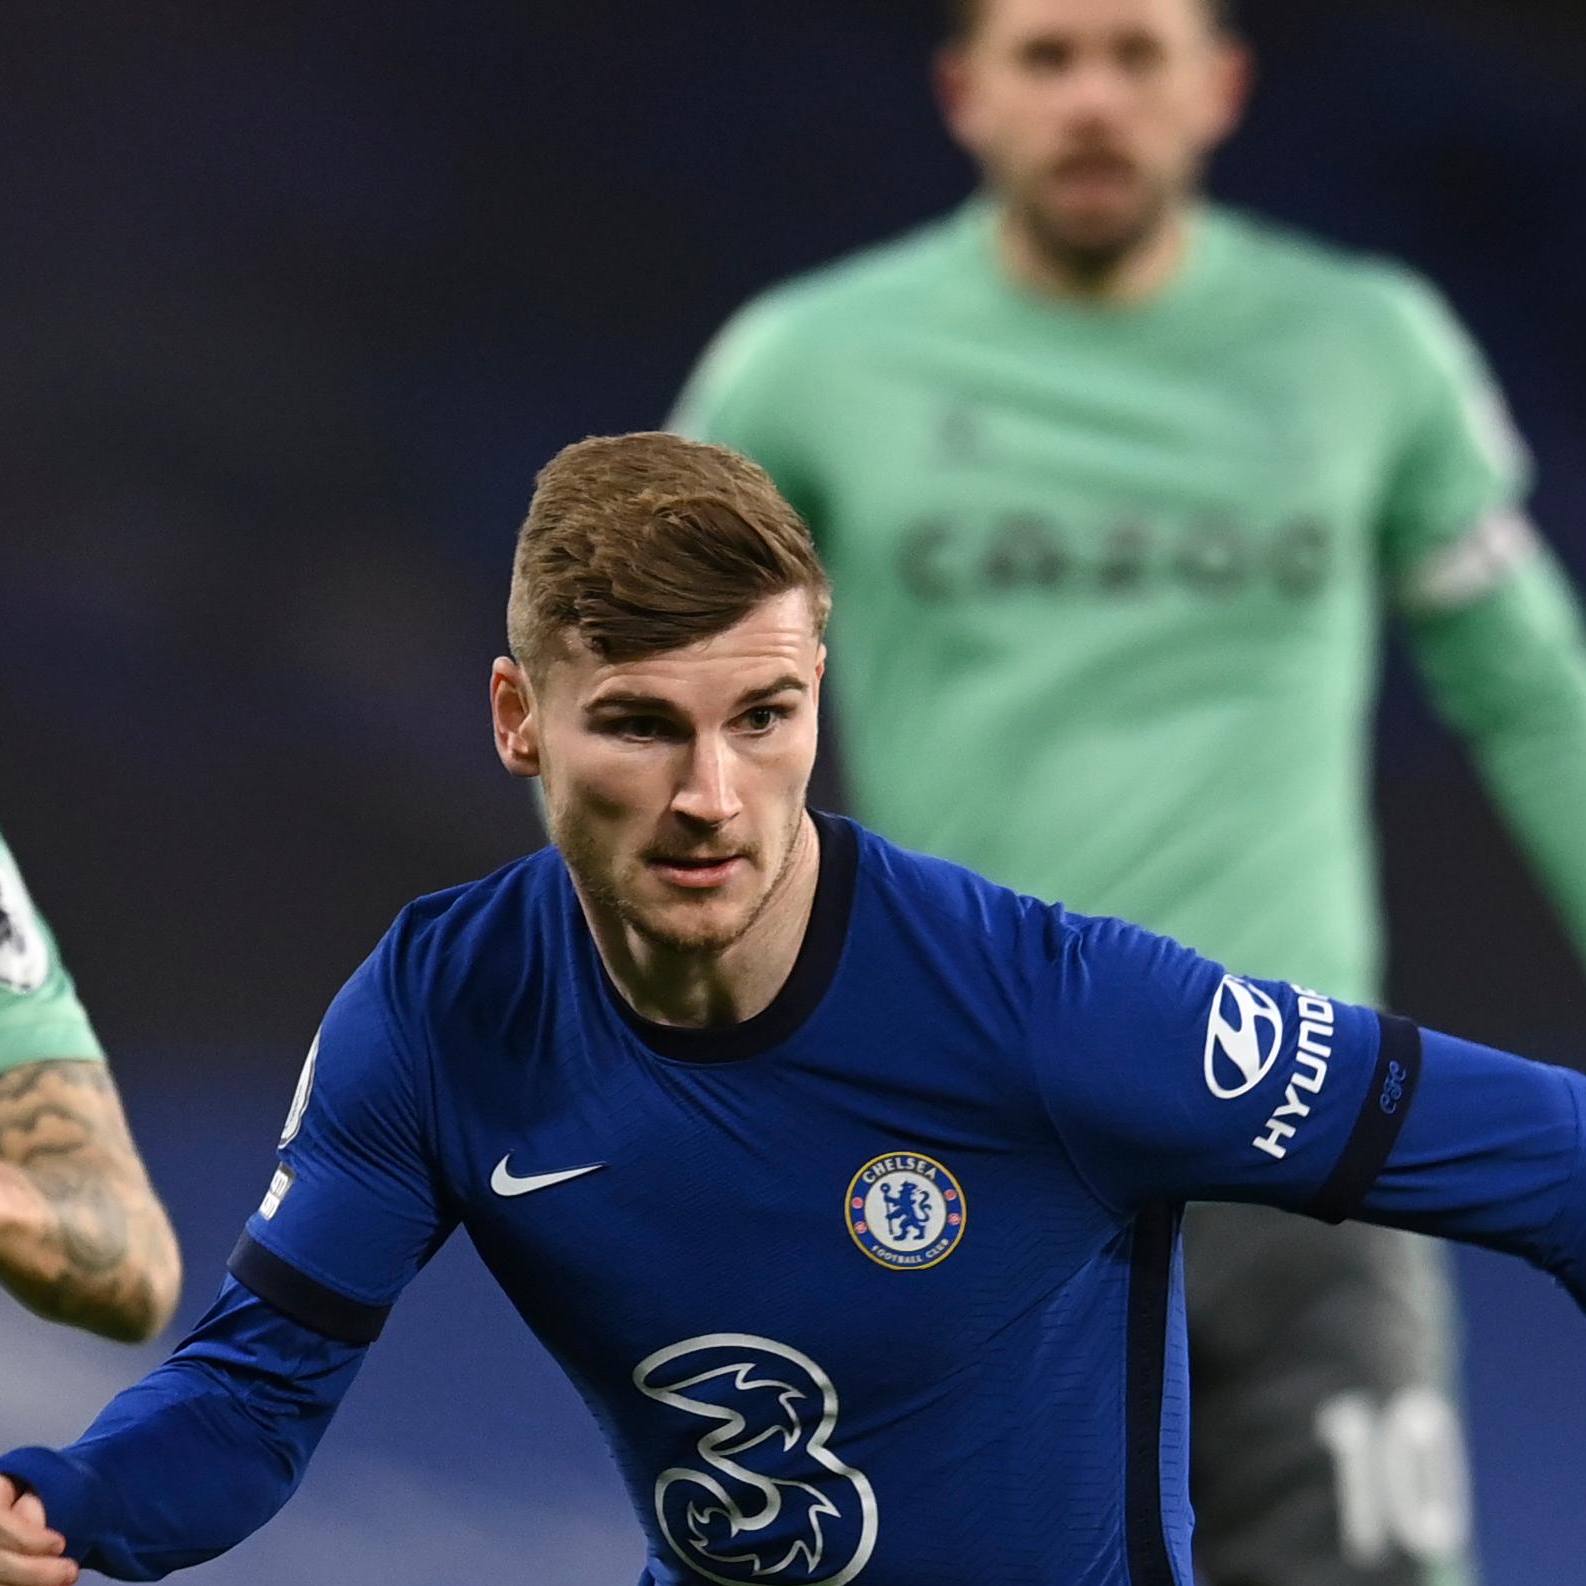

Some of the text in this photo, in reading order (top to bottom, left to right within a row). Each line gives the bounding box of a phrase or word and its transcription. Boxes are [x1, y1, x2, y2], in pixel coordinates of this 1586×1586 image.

[862, 1157, 938, 1183] CHELSEA
[871, 1244, 923, 1264] FOOTBALL
[1314, 1390, 1468, 1564] 10
